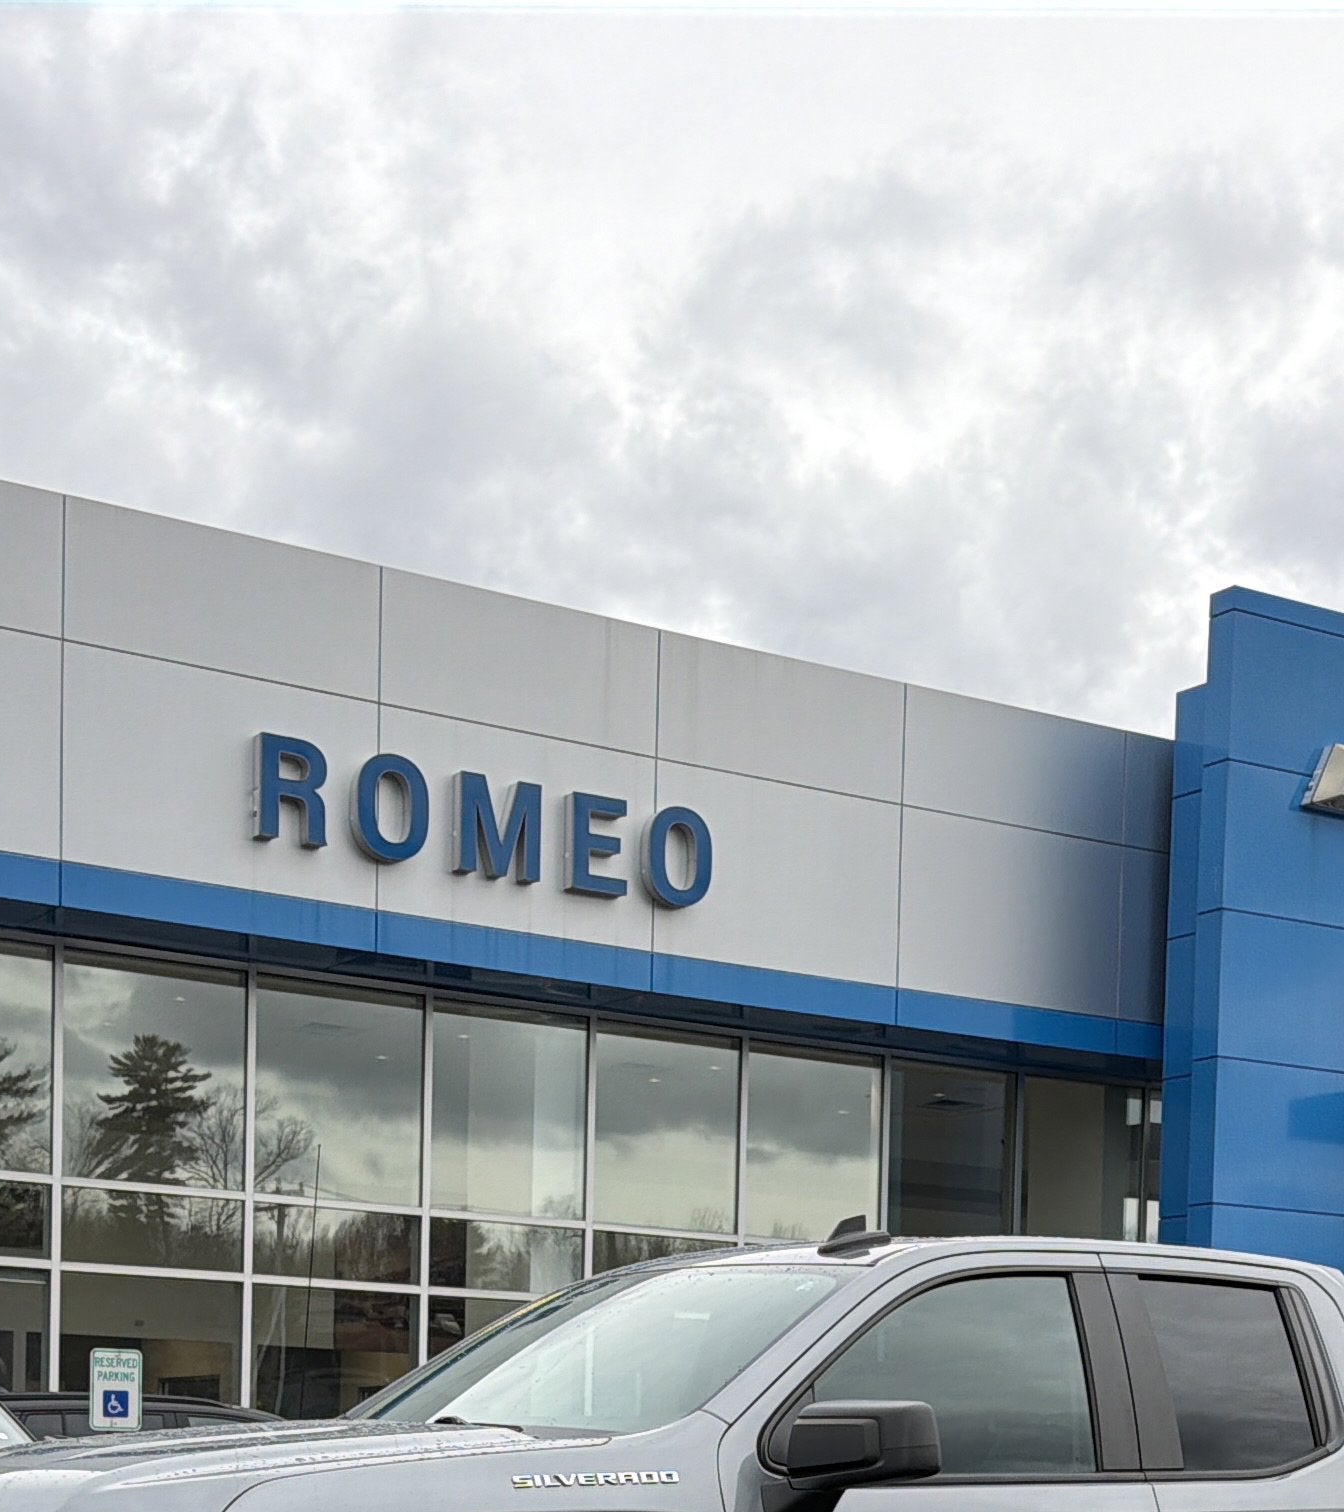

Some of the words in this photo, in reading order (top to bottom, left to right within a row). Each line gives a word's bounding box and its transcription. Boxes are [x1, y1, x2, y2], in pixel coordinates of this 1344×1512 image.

[252, 731, 714, 909] ROMEO
[94, 1356, 138, 1369] RESERVED
[97, 1370, 136, 1382] PARKING
[512, 1470, 679, 1489] SILVERADO
